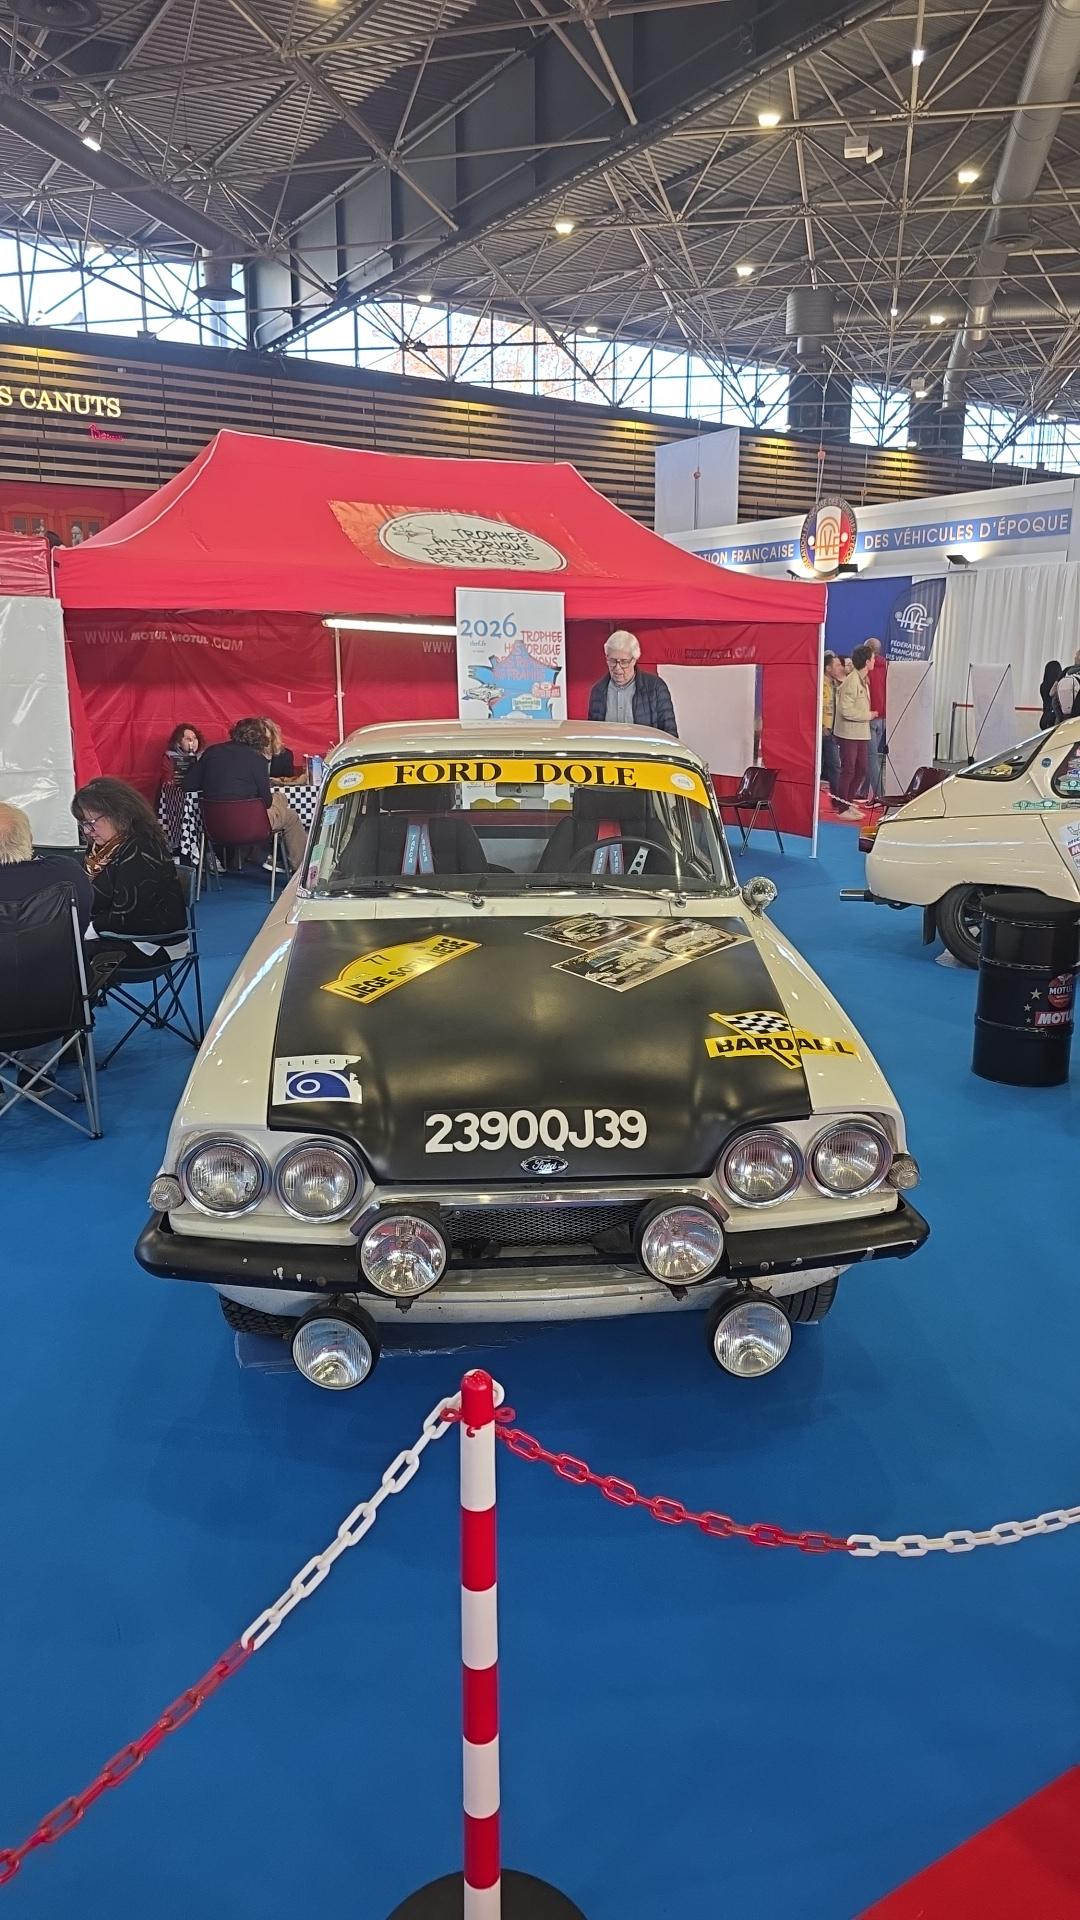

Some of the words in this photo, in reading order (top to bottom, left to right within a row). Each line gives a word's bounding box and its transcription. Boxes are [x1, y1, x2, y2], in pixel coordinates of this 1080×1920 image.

[20, 387, 122, 418] CANUTS
[452, 528, 529, 544] TROPHEE
[731, 543, 795, 563] FRANÇAISE
[863, 534, 889, 550] DES
[893, 523, 974, 546] VÉHICULES
[979, 514, 1070, 539] D'ÉPOQUE
[422, 547, 457, 557] DES
[433, 537, 535, 552] HISTORIQUE
[460, 612, 518, 638] 2026
[130, 630, 168, 641] MOTUL
[520, 630, 563, 642] TROPHEE
[393, 762, 502, 785] FORD
[533, 762, 638, 788] DOLE
[363, 954, 392, 966] 77
[335, 975, 395, 1000] LIEGE
[430, 937, 470, 959] LIEGE
[425, 1108, 648, 1154] 2390QJ39
[531, 1159, 558, 1172] Ford
